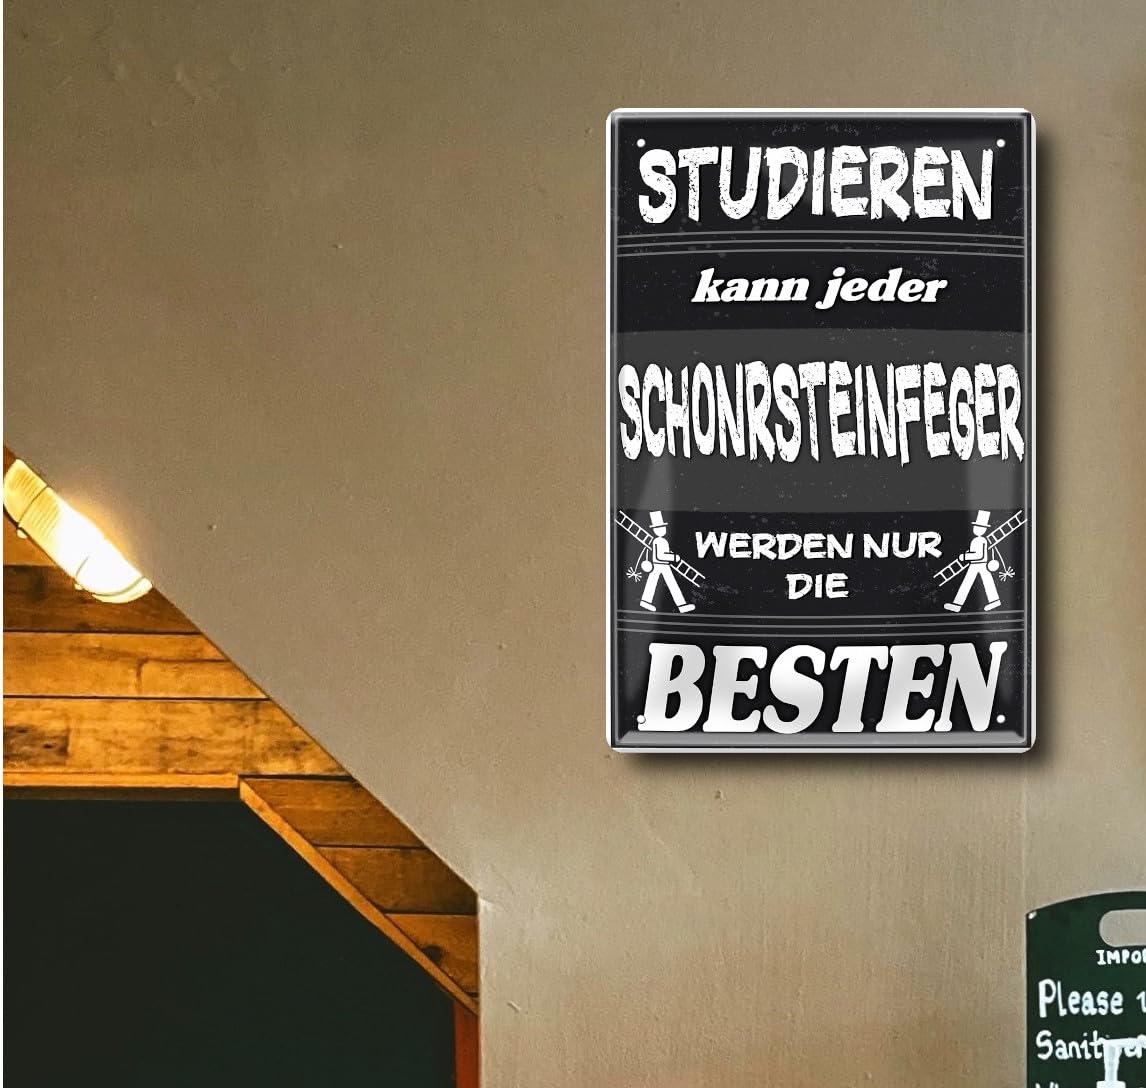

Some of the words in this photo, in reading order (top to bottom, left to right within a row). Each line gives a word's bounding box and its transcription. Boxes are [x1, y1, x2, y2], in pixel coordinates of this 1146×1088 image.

[638, 145, 994, 224] STUDIEREN
[691, 267, 810, 303] kann
[815, 266, 949, 310] jeder
[618, 361, 1025, 467] SCHONRSTEINFEGER
[695, 531, 854, 560] WERDEN
[863, 531, 943, 560] NUR
[785, 573, 850, 600] DIE
[637, 641, 1008, 734] BESTEN
[1038, 979, 1124, 1018] Please
